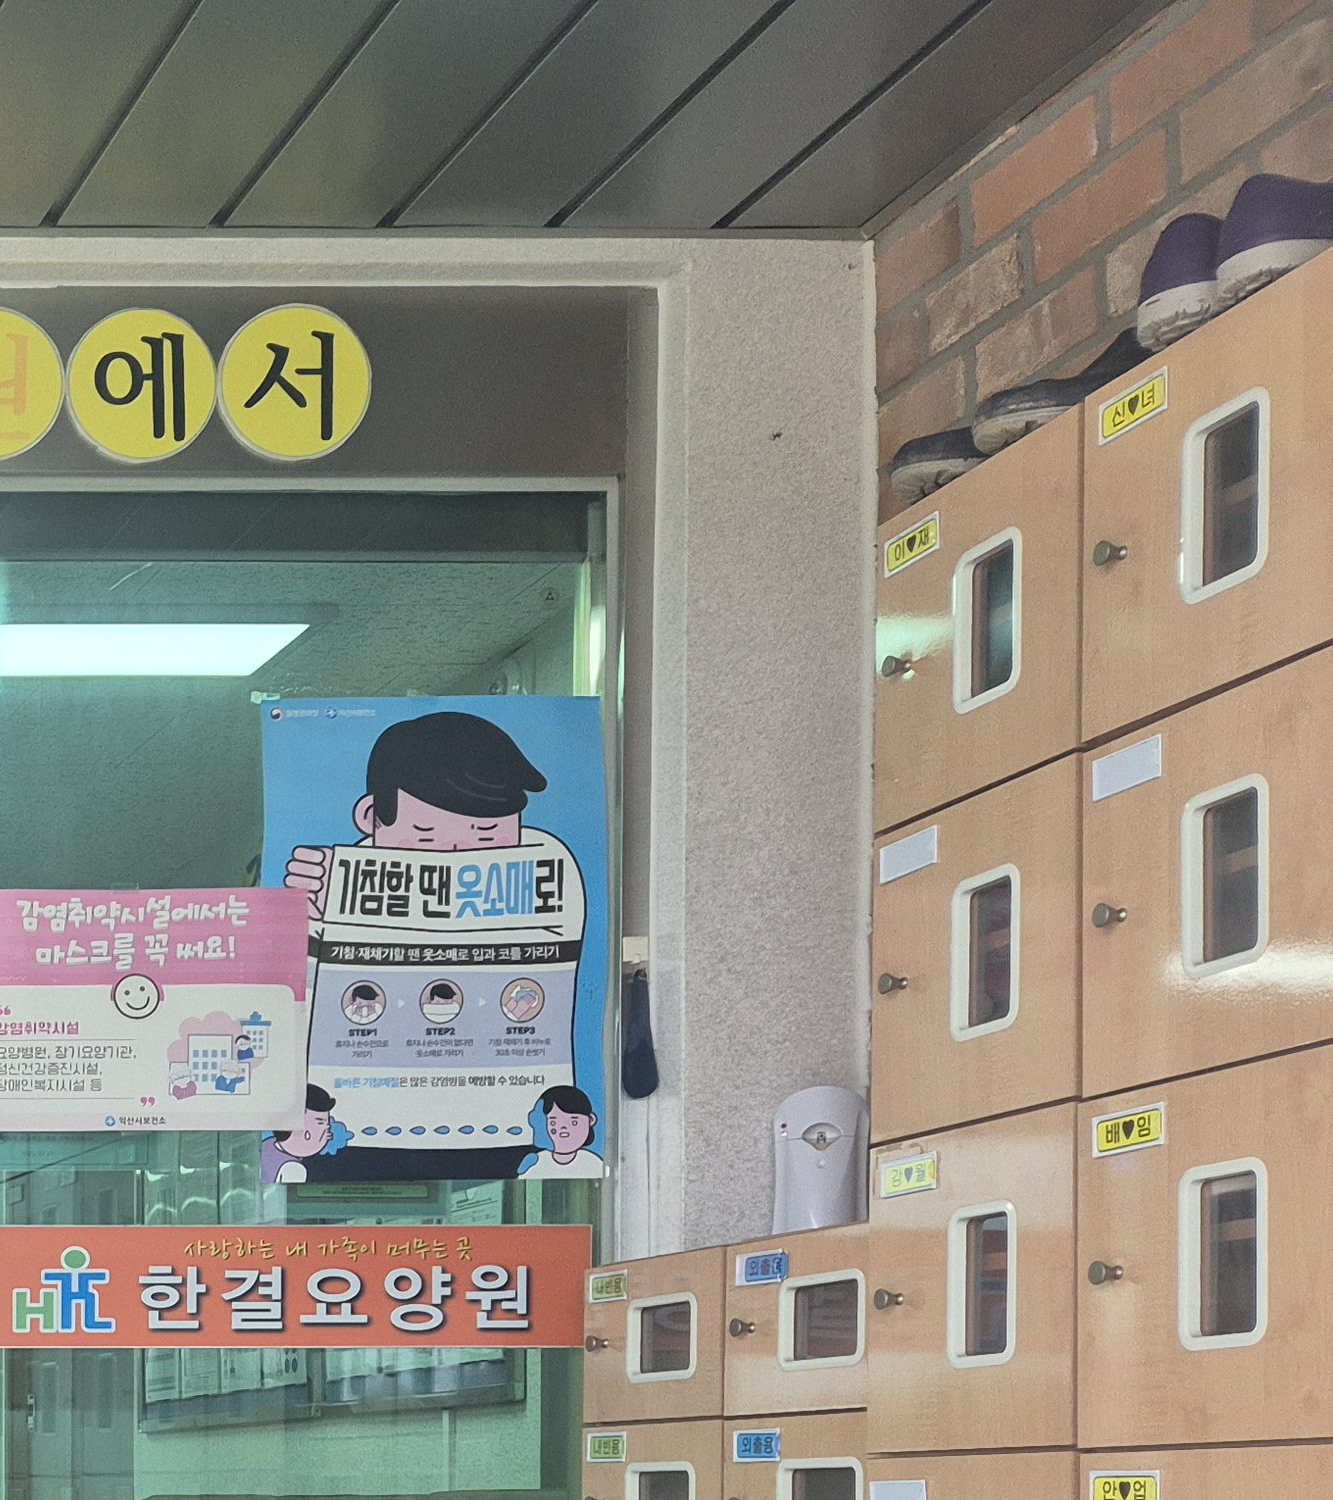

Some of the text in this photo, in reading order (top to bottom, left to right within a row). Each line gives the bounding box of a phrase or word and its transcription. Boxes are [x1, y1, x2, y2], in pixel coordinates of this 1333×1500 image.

[339, 858, 564, 919] 기침할 땐 옷소매로!
[16, 895, 250, 933] 감염취약시설에서는
[35, 932, 236, 972] 마스크를 꼭 써요!
[408, 947, 420, 961] 땐
[423, 948, 469, 962] 옷소매로
[472, 947, 496, 961] 입과
[498, 947, 522, 960] 코를
[524, 945, 560, 960] 가리기
[349, 1026, 535, 1037] STEP1 STEP2 STEP3
[55, 1045, 137, 1060] 장기요양기관,
[90, 1078, 102, 1092] 등
[498, 1075, 507, 1086] 수
[509, 1074, 545, 1087] 있습니다
[119, 1115, 166, 1126] 익산시보건소
[184, 1236, 473, 1261] 사랑하는 내 가족이 머무는 곳
[138, 1264, 532, 1332] 한결요양원
